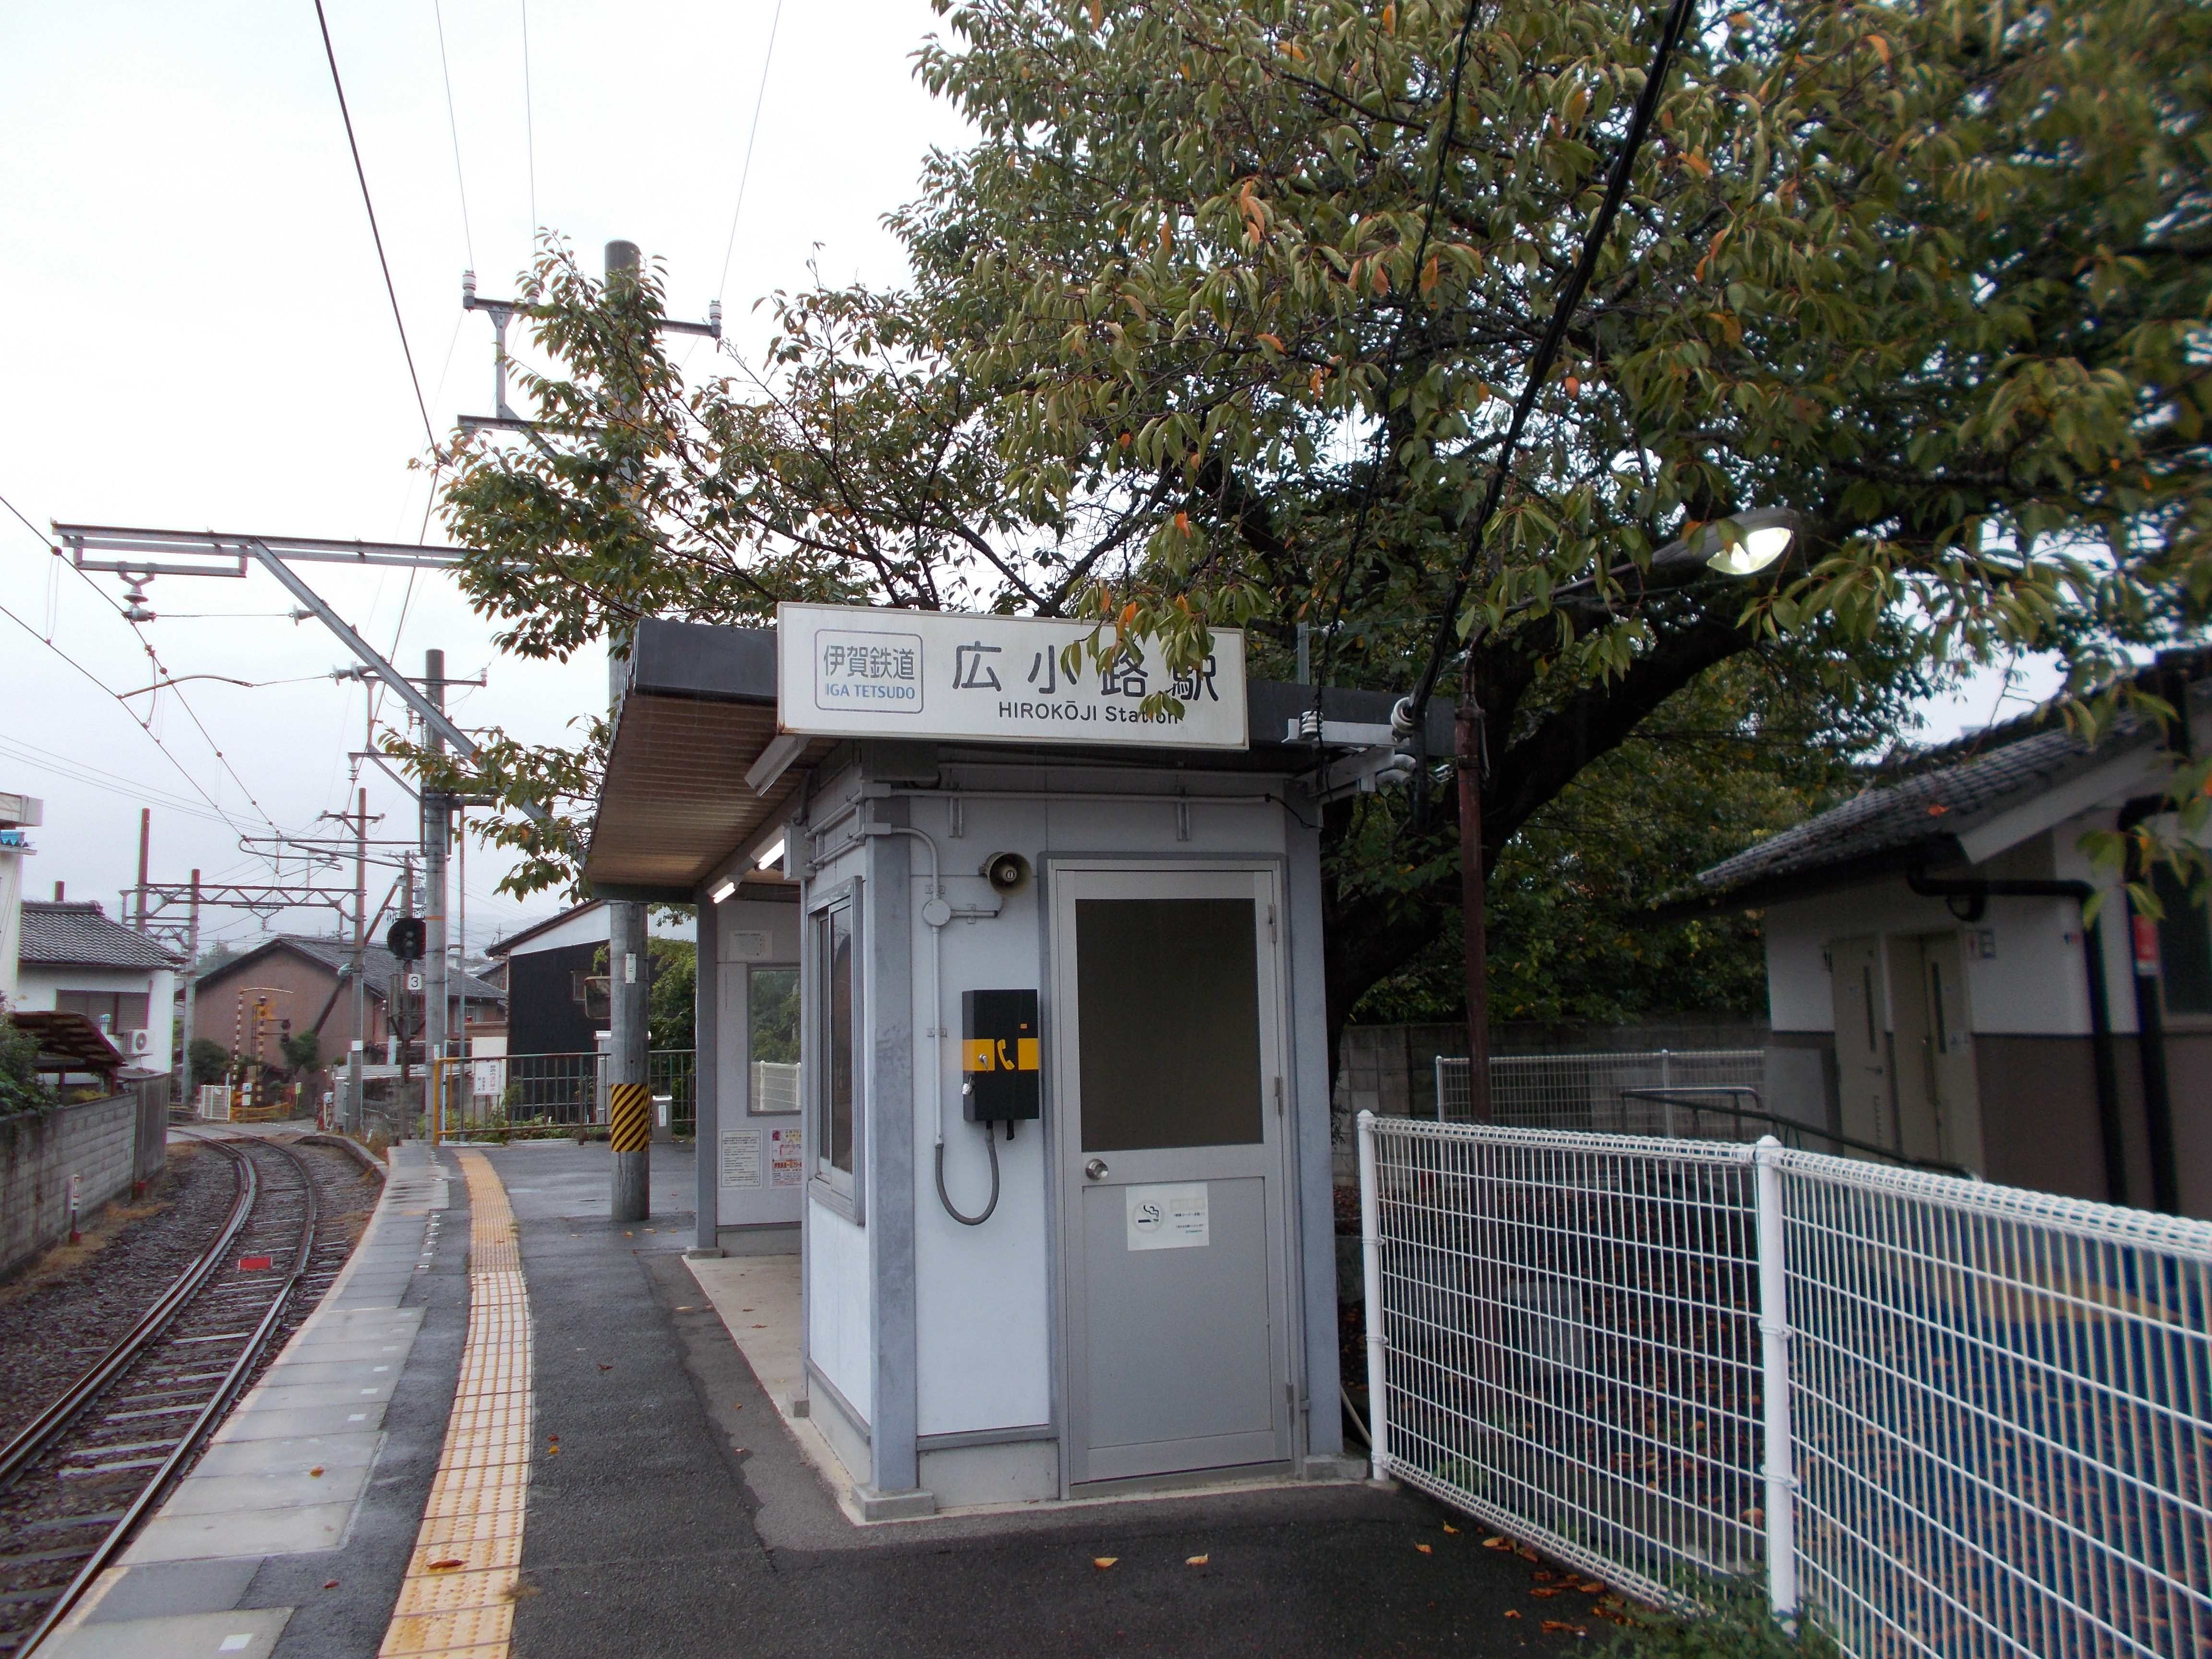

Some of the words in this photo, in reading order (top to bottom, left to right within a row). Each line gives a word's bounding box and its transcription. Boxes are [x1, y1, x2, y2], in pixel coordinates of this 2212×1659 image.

[823, 645, 915, 680] 伊賀鉄道
[952, 641, 1219, 701] 広小路駅
[826, 683, 850, 697] IGA
[854, 685, 915, 699] TETSUDO
[999, 700, 1097, 721] HIROKŌJI
[1105, 705, 1178, 724] Staton
[411, 976, 418, 987] 3
